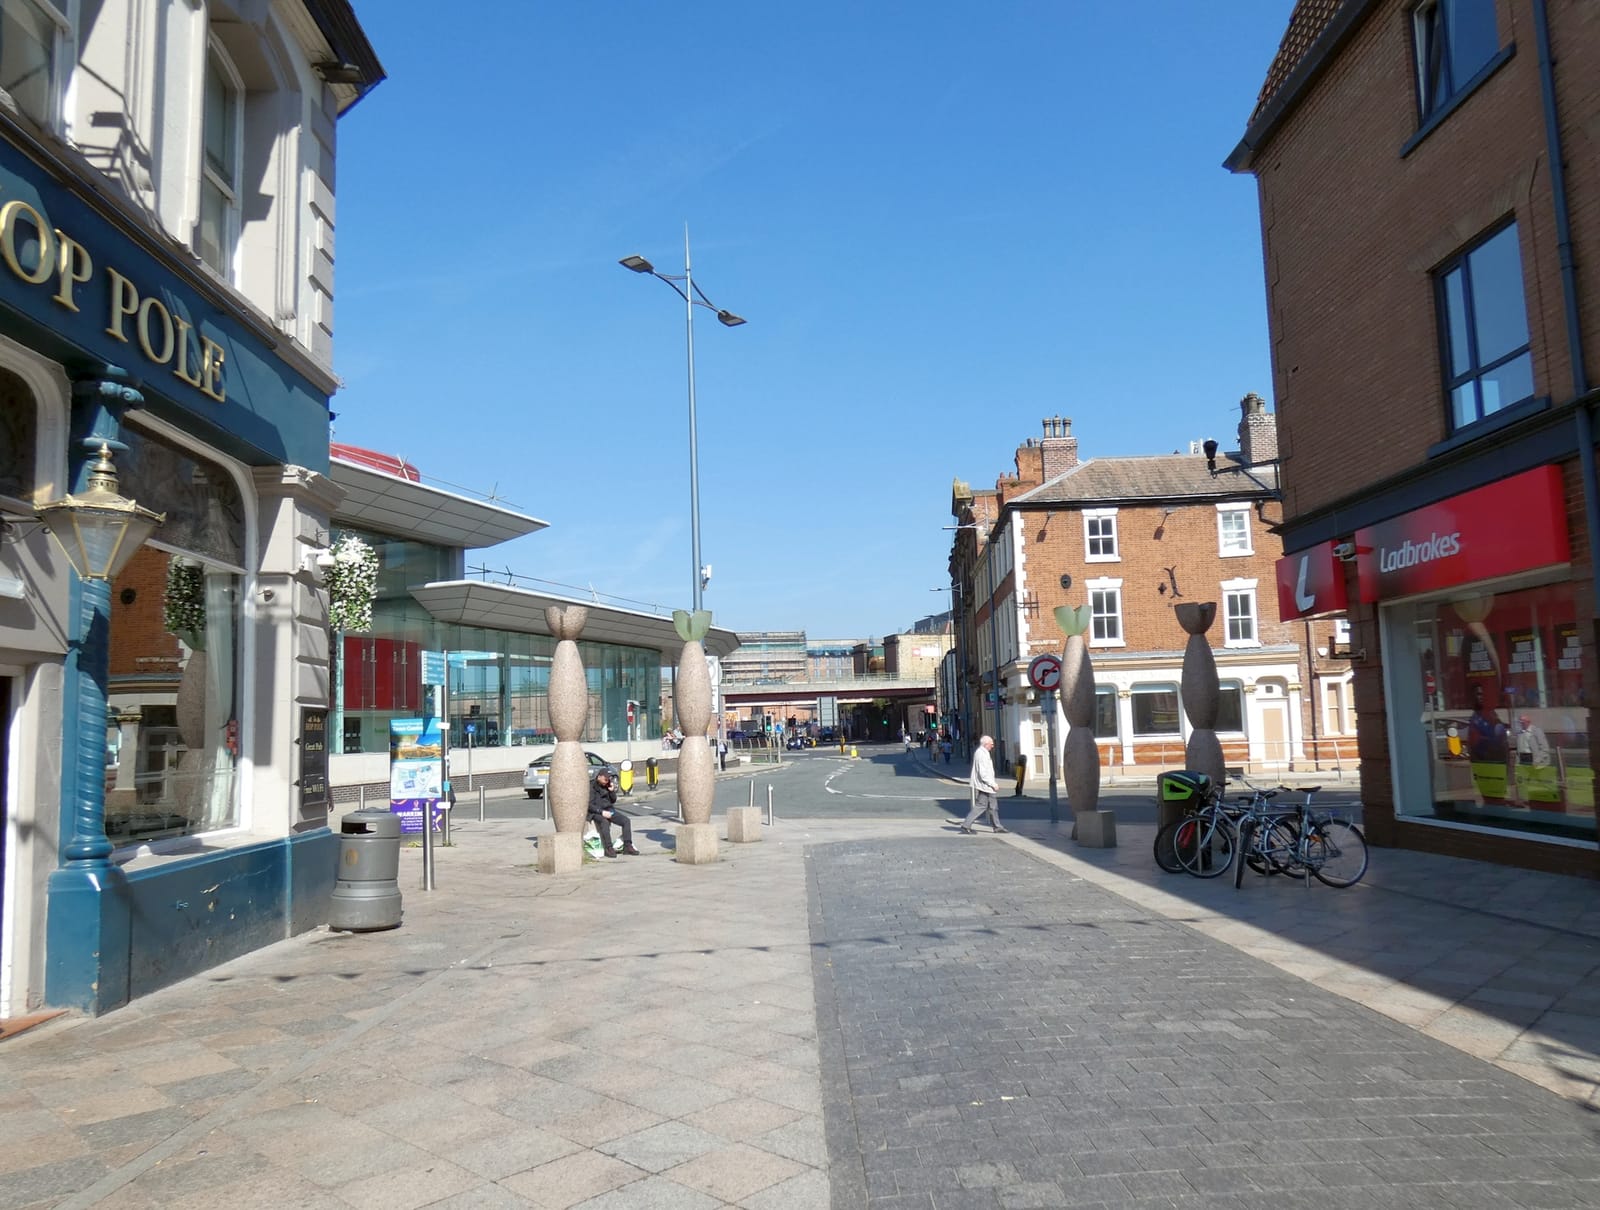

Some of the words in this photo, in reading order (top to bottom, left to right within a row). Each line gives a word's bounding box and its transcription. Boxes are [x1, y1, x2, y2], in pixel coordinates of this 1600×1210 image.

[0, 200, 93, 312] OP
[105, 267, 225, 402] POLE
[1380, 532, 1460, 573] Ladbrokes
